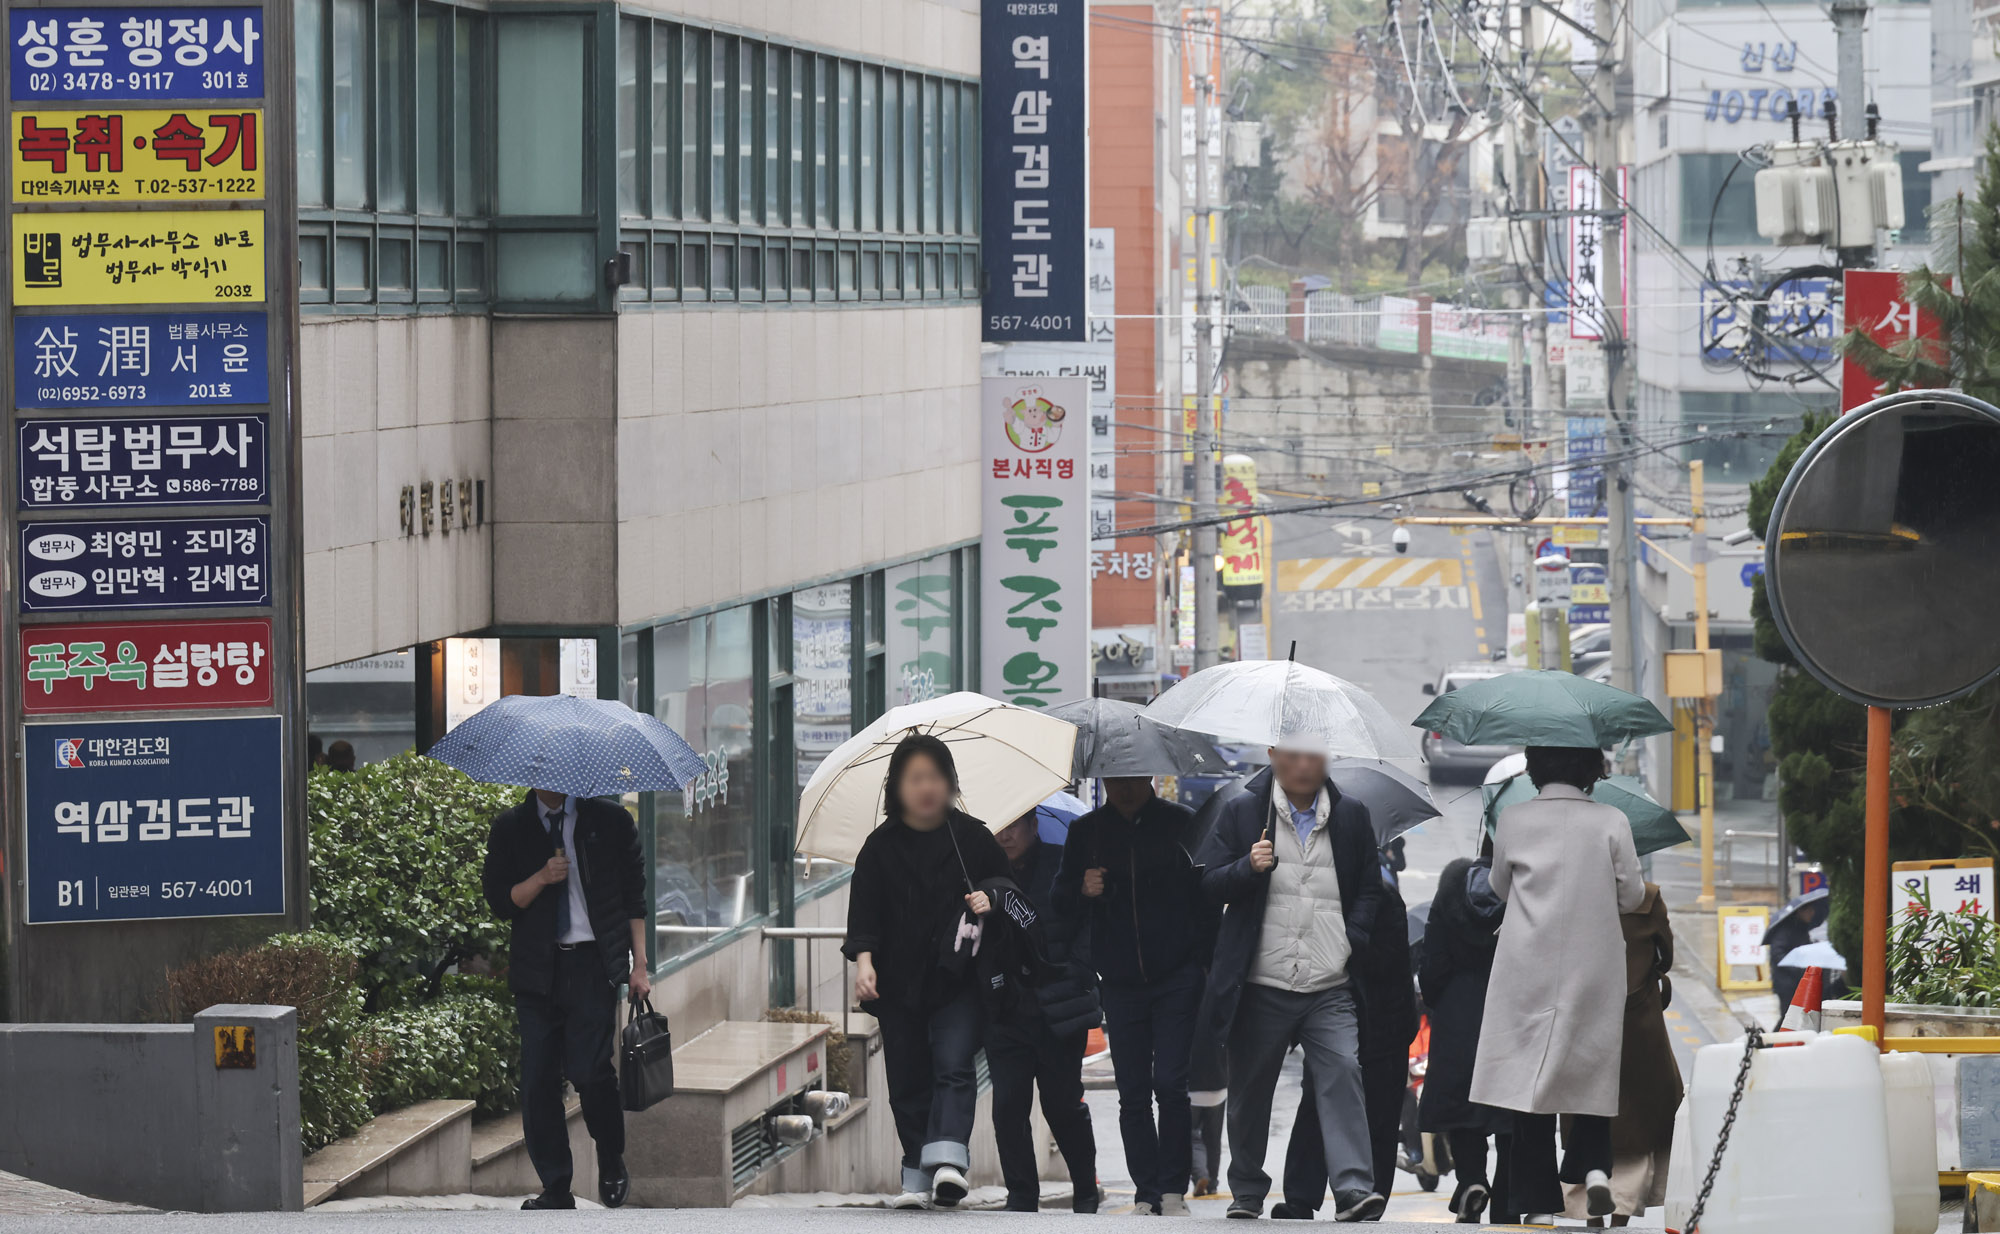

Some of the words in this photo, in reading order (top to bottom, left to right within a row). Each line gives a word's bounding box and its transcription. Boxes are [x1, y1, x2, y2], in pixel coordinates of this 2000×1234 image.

[1007, 3, 1058, 15] 대한검도회
[18, 17, 109, 68] 성훈
[120, 17, 260, 67] 행정사
[202, 71, 249, 89] 301호
[1011, 35, 1052, 297] 역삼검도관
[21, 180, 121, 196] 다인속기사무소
[134, 178, 256, 195] T.02-537-1222
[72, 231, 201, 259] 법무사사무소
[214, 230, 254, 248] 바로
[106, 261, 165, 285] 법무사
[171, 257, 228, 281] 박익기
[215, 285, 253, 298] 203호
[168, 322, 249, 341] 법률사무소
[189, 383, 233, 399] 201호
[992, 458, 1074, 480] 본사직영
[183, 478, 258, 493] 586-7788
[39, 540, 76, 553] 법무사
[40, 577, 76, 590] 법무사
[1000, 495, 1064, 708] 푸주옥
[28, 640, 148, 694] 푸주옥
[153, 641, 265, 688] 설렁탕
[88, 737, 170, 757] 대한검도회
[88, 759, 109, 767] KOREA
[110, 759, 132, 767] KUMDO
[133, 758, 170, 767] ASSOCIATION
[54, 796, 255, 843] 역삼검도관
[58, 880, 84, 907] B1
[108, 885, 150, 899] 입관문의
[1803, 873, 1822, 895] P
